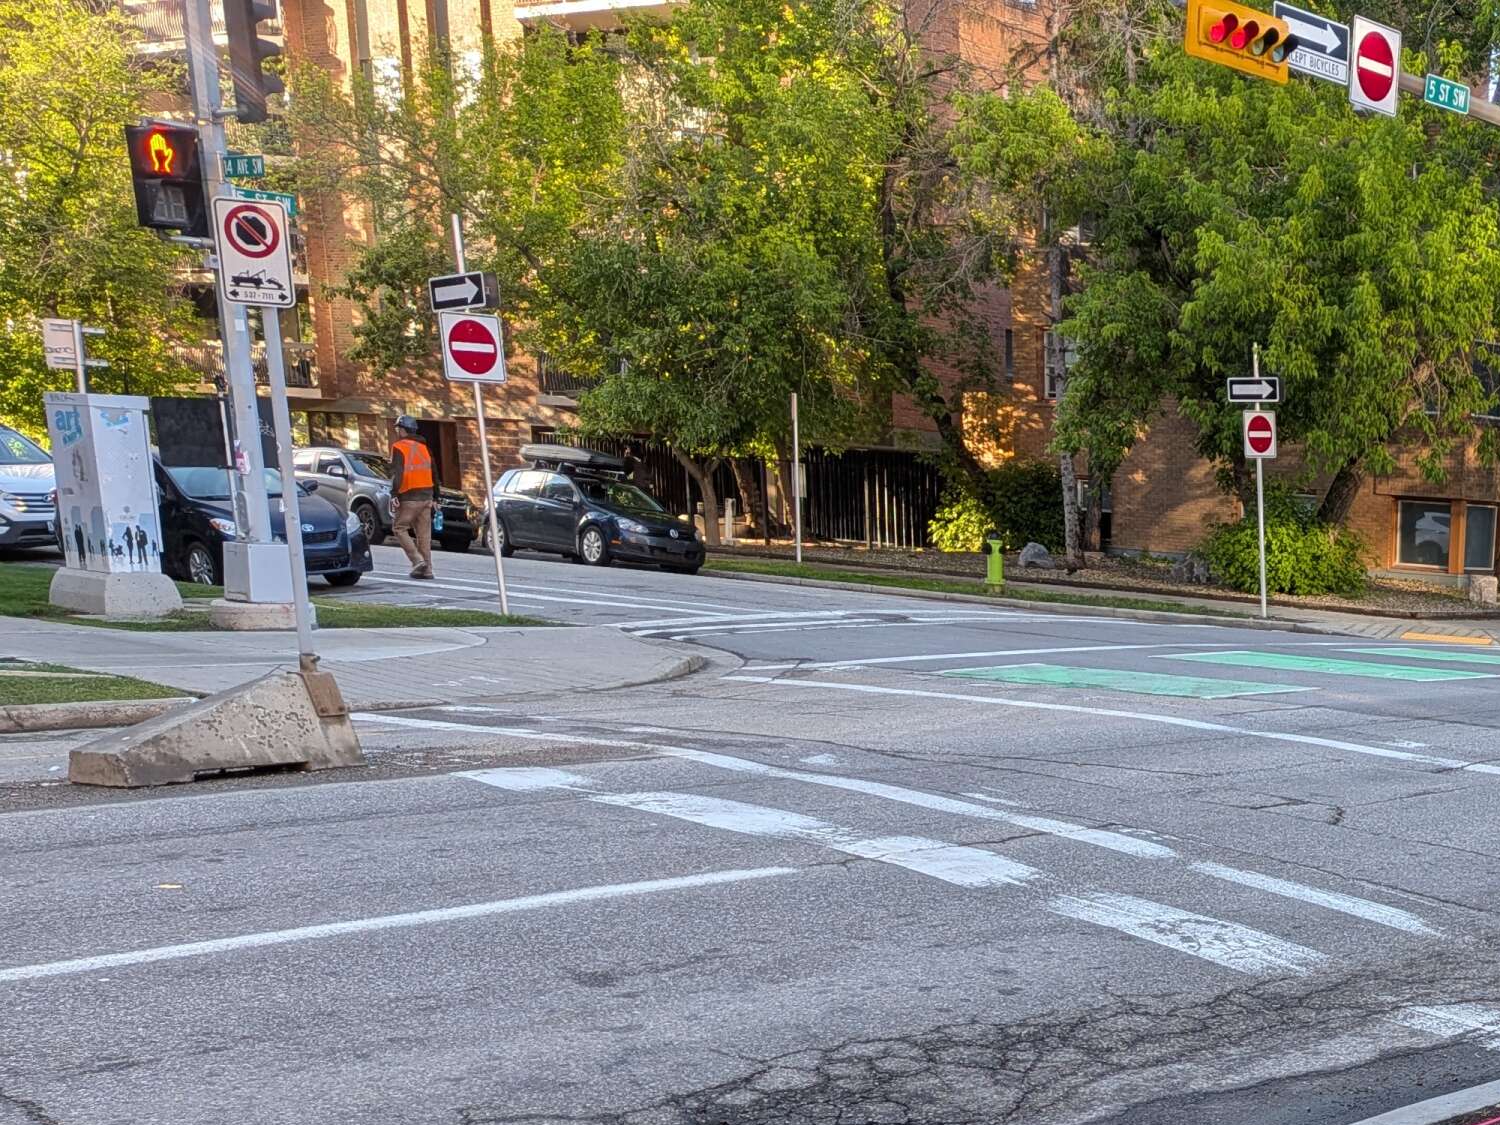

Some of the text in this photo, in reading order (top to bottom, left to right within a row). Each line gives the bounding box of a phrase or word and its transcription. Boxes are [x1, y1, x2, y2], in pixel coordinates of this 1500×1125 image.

[1289, 51, 1339, 76] CEPT BICYCLES
[1428, 79, 1466, 109] 5 ST SW
[237, 159, 249, 175] AVE
[252, 158, 263, 174] SW
